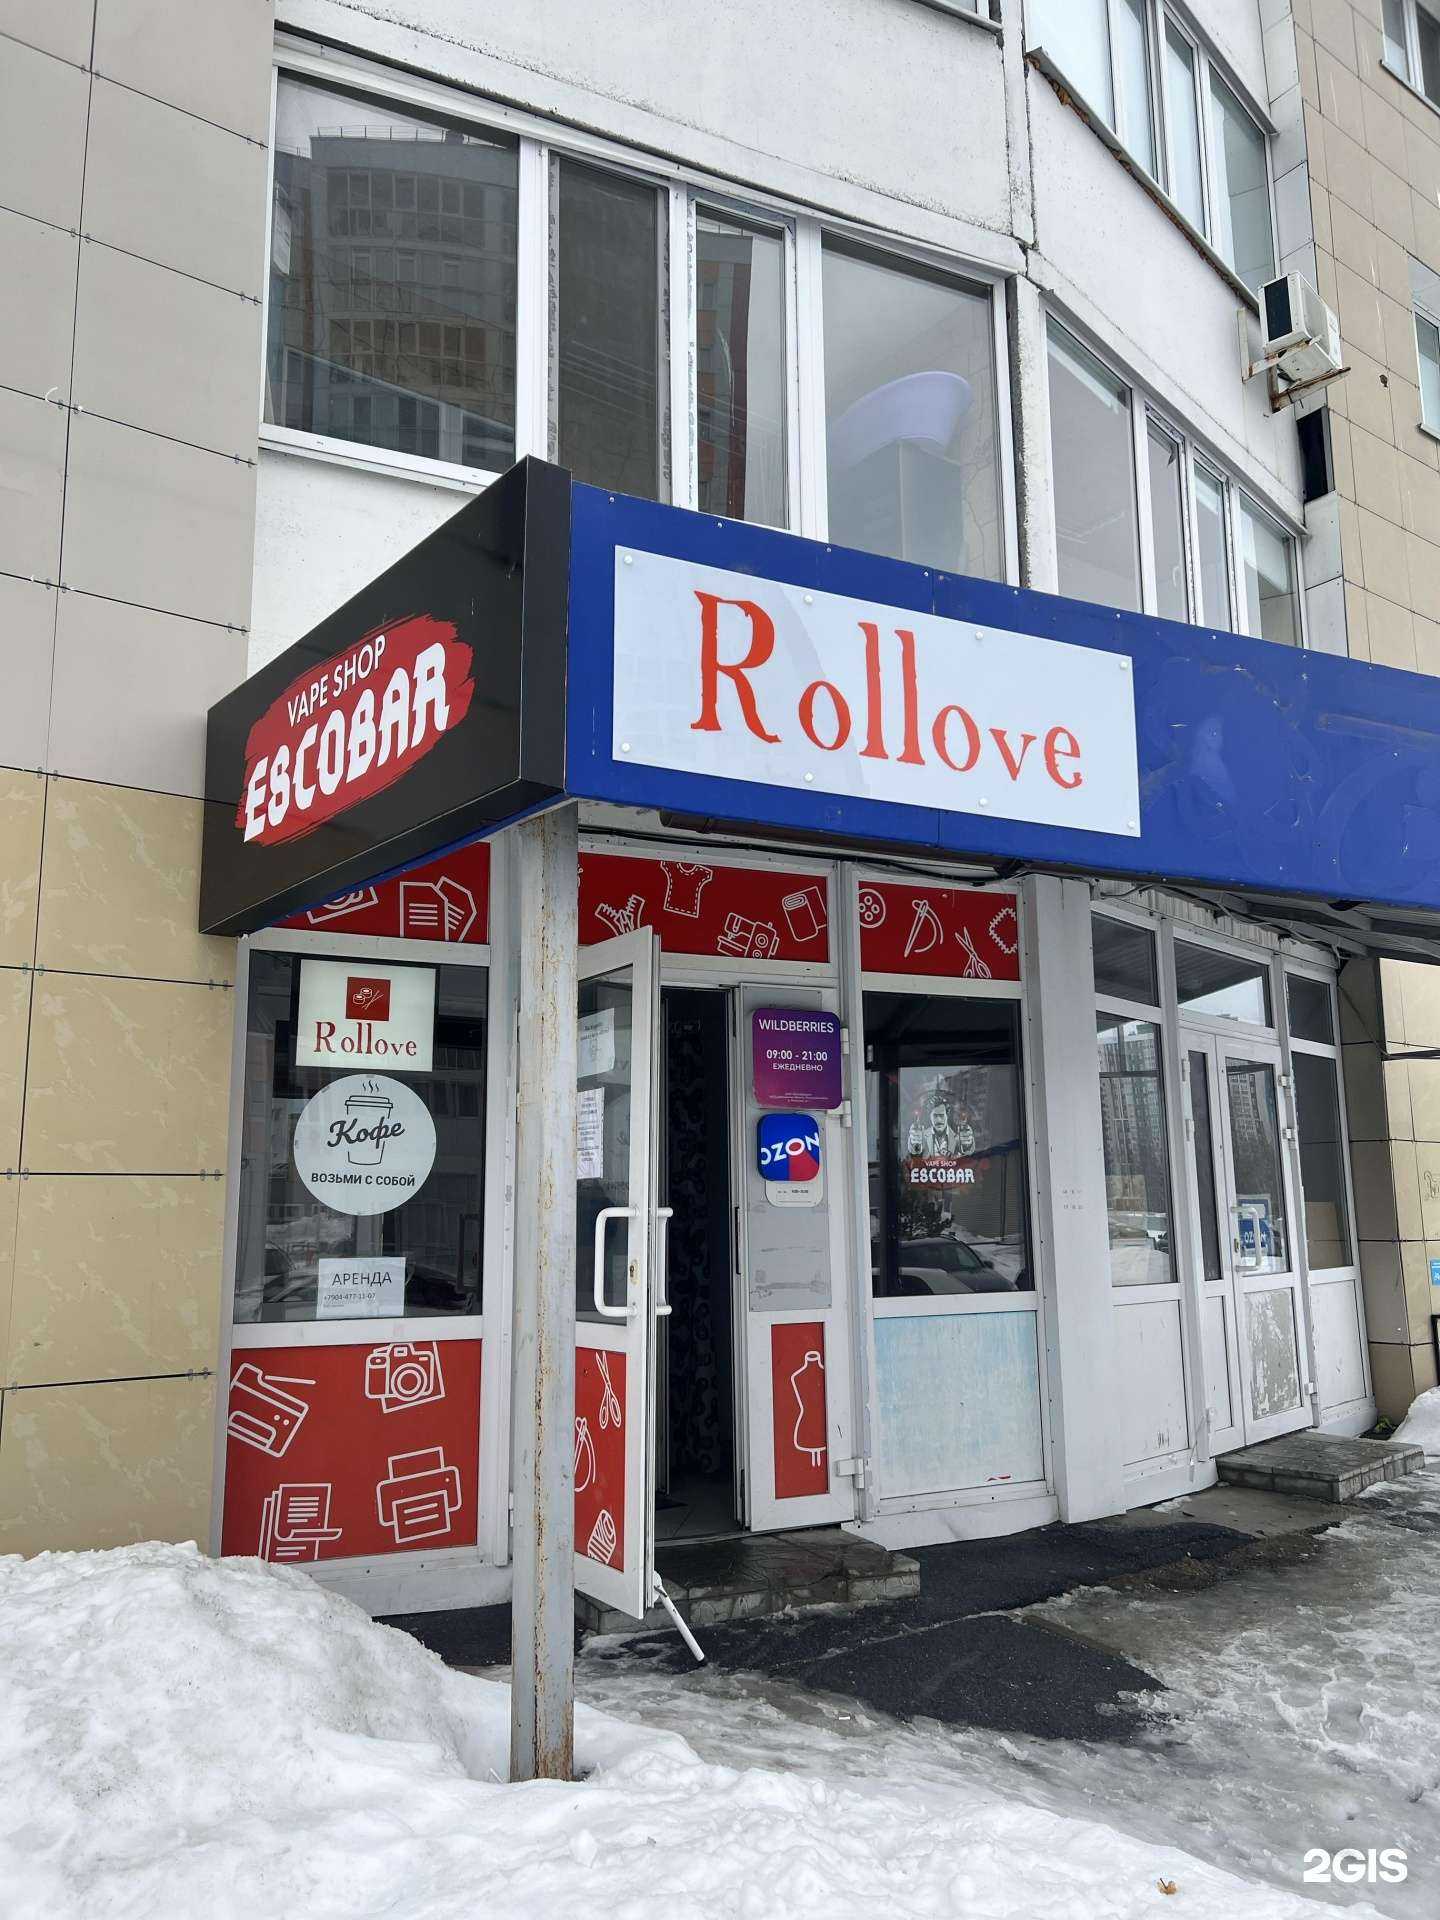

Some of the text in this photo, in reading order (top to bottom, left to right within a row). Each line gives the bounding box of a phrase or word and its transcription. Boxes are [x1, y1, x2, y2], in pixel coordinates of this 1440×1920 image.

[287, 634, 386, 727] VAPE SHOP
[690, 590, 1083, 790] Rollove
[243, 642, 450, 843] ESCOBAR
[758, 1018, 834, 1034] WILDBERRIES
[313, 1020, 418, 1057] Rollove
[766, 1049, 793, 1060] 09:00
[801, 1050, 828, 1061] 21:00
[772, 1062, 823, 1072] ЕЖЕДНЕВНО
[326, 1116, 406, 1149] Кофе
[311, 1172, 362, 1185] ВОЗЬМИ
[375, 1173, 415, 1187] СОБОЙ
[910, 1167, 975, 1184] ESCOBAR
[1244, 1230, 1266, 1243] OZN
[332, 1271, 392, 1287] АРЕНДА
